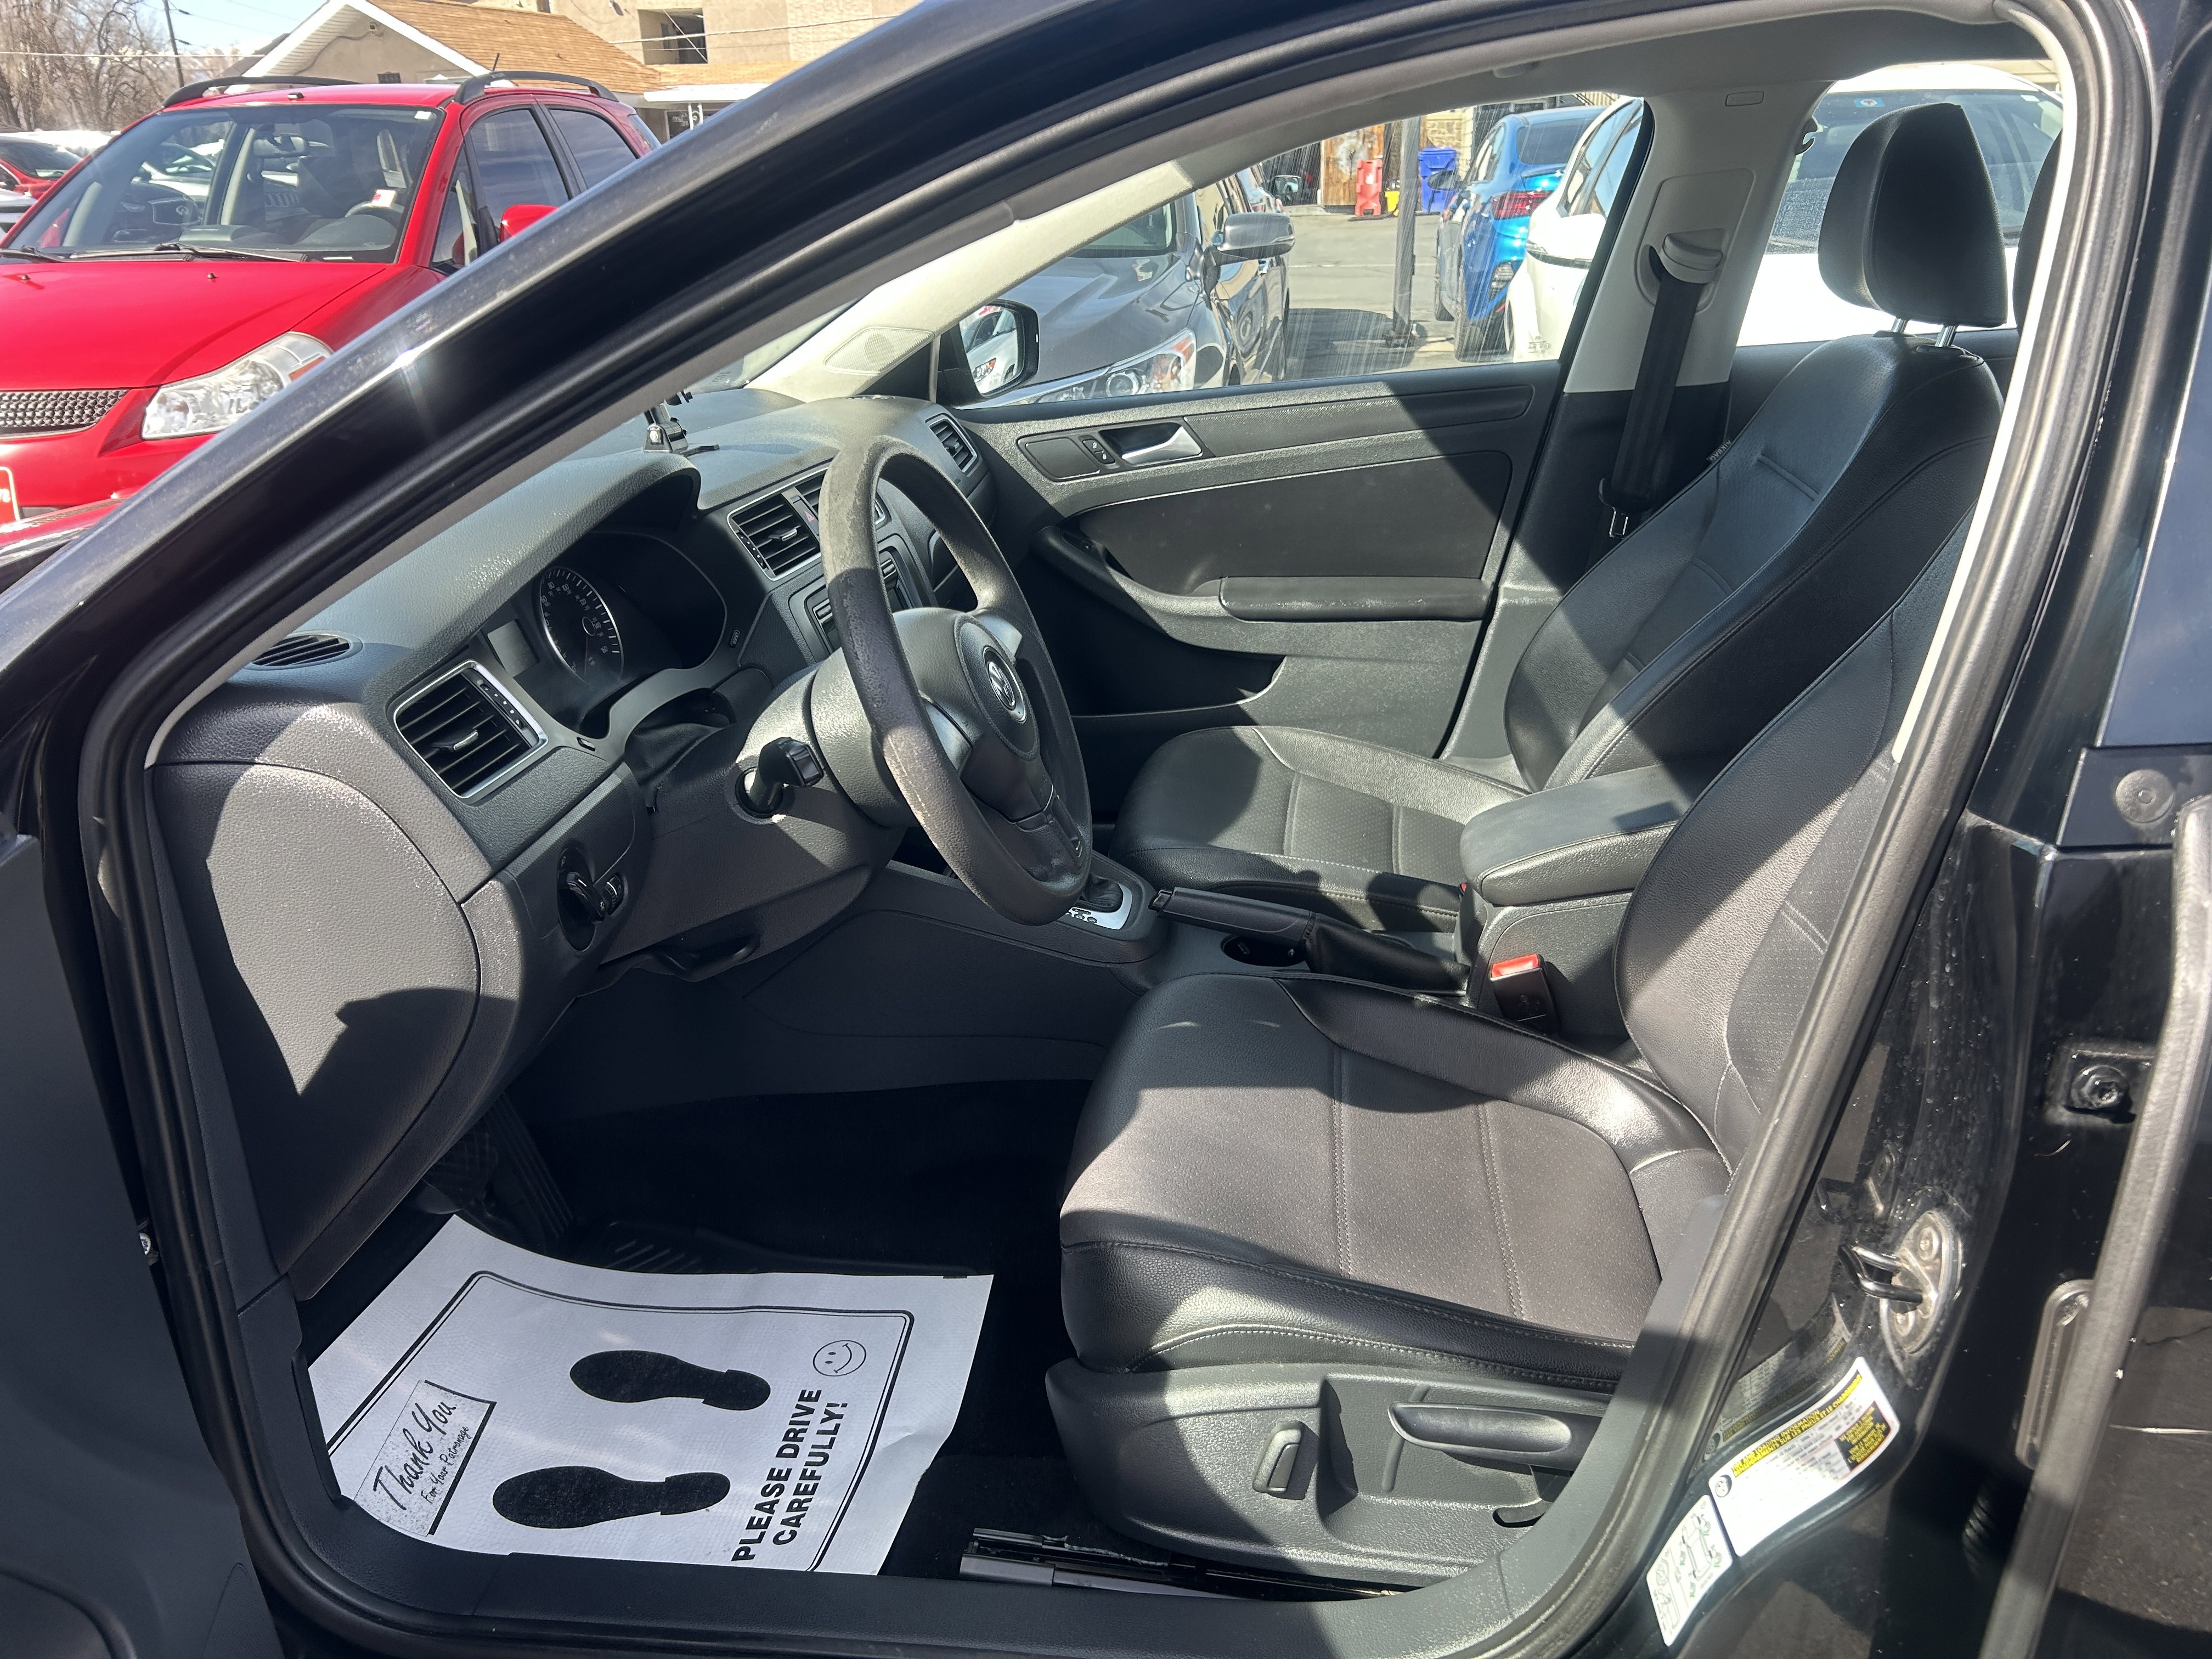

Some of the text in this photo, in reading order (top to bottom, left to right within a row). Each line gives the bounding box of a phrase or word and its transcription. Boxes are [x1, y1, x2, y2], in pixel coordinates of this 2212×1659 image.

[1709, 440, 1731, 460] AIRBAG
[373, 1401, 457, 1510] Thank You
[421, 1426, 473, 1504] For Your Patronage
[772, 1402, 848, 1545] CAREFULLY!
[1741, 1451, 1756, 1463] AND
[1754, 1434, 1781, 1455] LOADING
[1779, 1408, 1821, 1438] INFORMATION
[1779, 1434, 1792, 1445] SUR
[731, 1389, 822, 1561] PLEASE DRIVE
